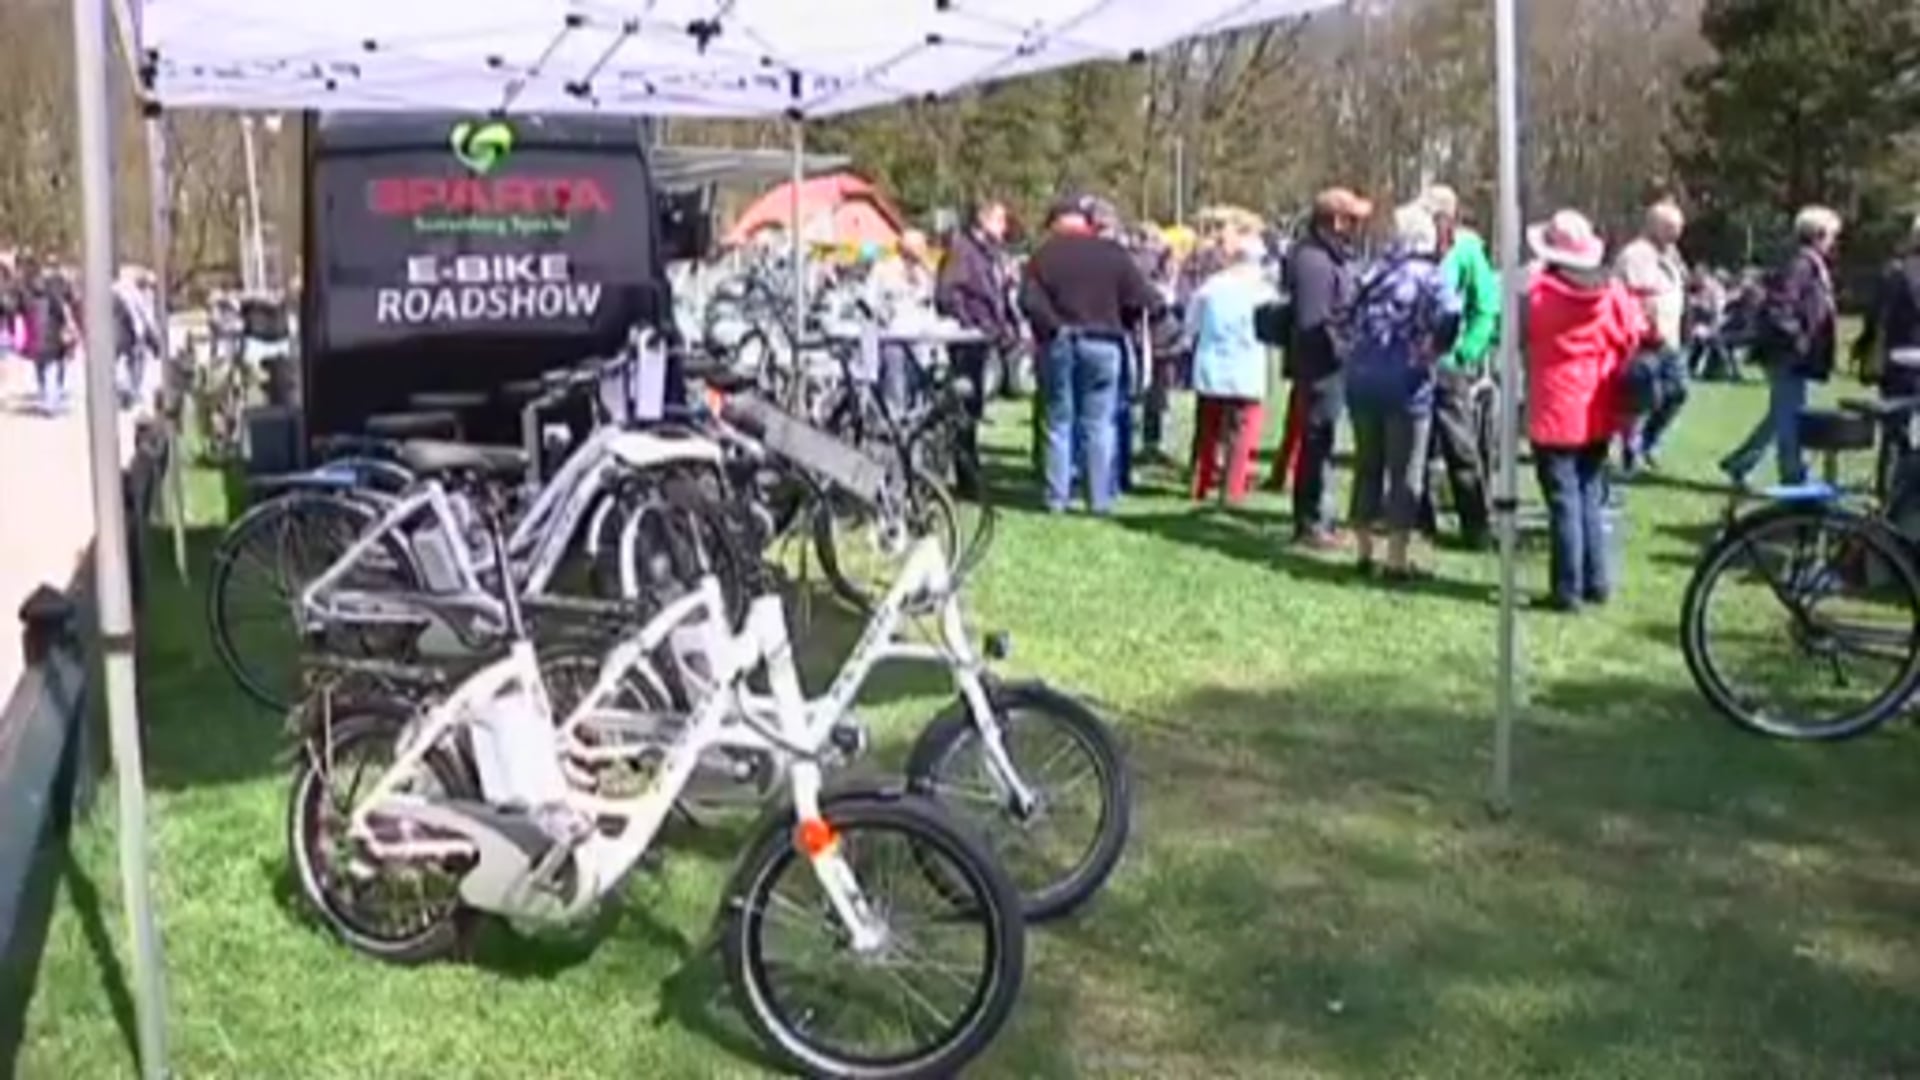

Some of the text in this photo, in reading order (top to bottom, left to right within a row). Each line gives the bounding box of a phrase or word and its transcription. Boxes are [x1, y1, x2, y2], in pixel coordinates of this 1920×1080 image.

[368, 176, 614, 213] SPARTA
[407, 253, 570, 283] E-BIKE
[377, 283, 601, 322] ROADSHOW
